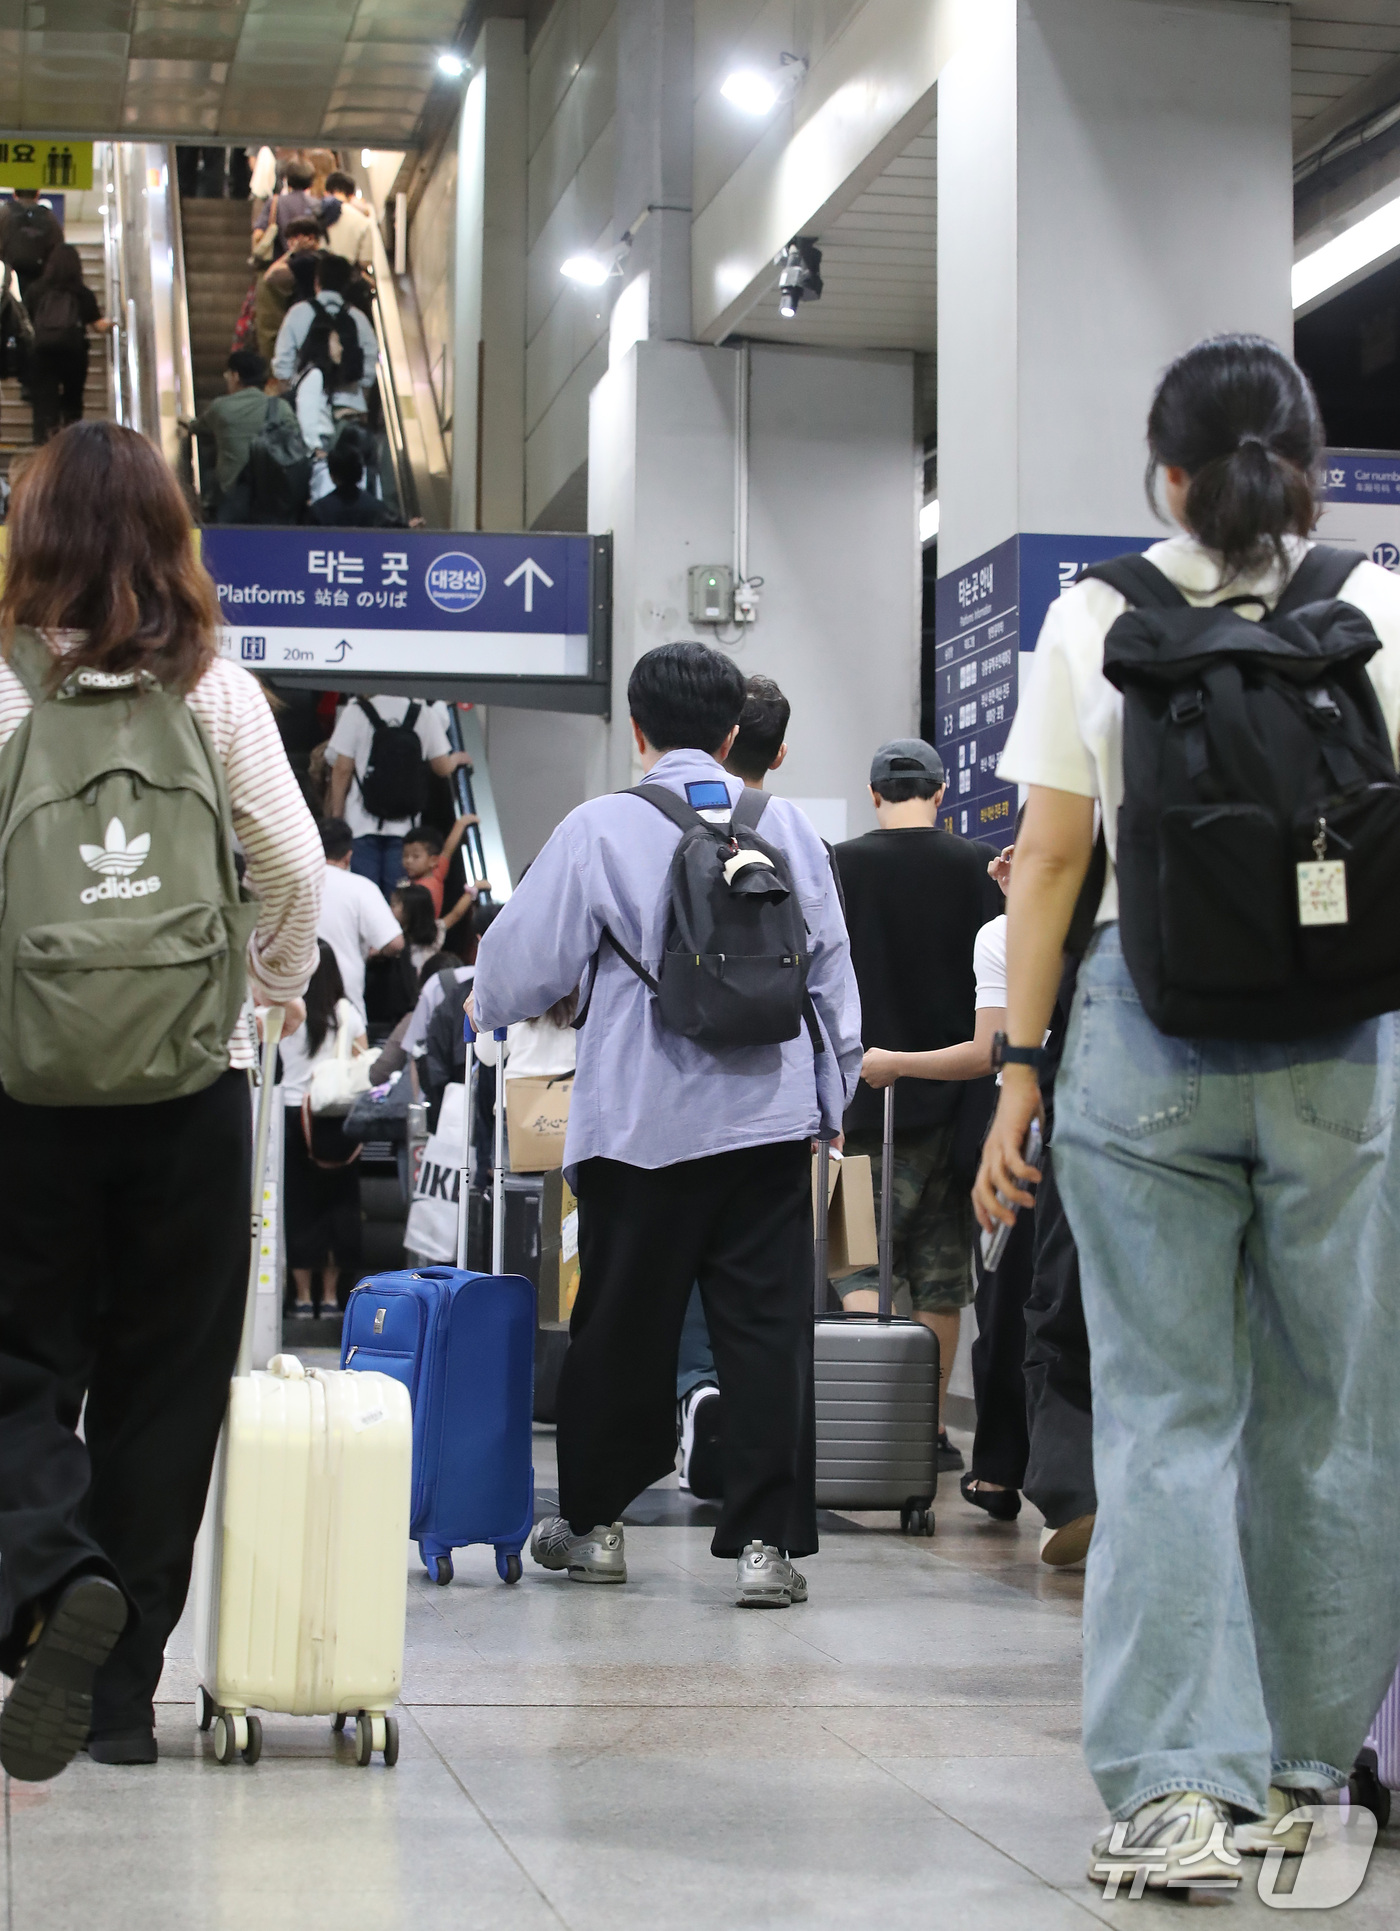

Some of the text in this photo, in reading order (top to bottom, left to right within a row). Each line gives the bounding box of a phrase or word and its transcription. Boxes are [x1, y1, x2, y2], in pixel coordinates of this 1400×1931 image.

[308, 550, 409, 586] 타는 곳
[1375, 547, 1397, 569] 12
[431, 569, 480, 591] 대경선
[216, 583, 407, 608] Platforms 站台 のりば
[283, 648, 315, 662] 20m
[80, 875, 161, 905] adidas
